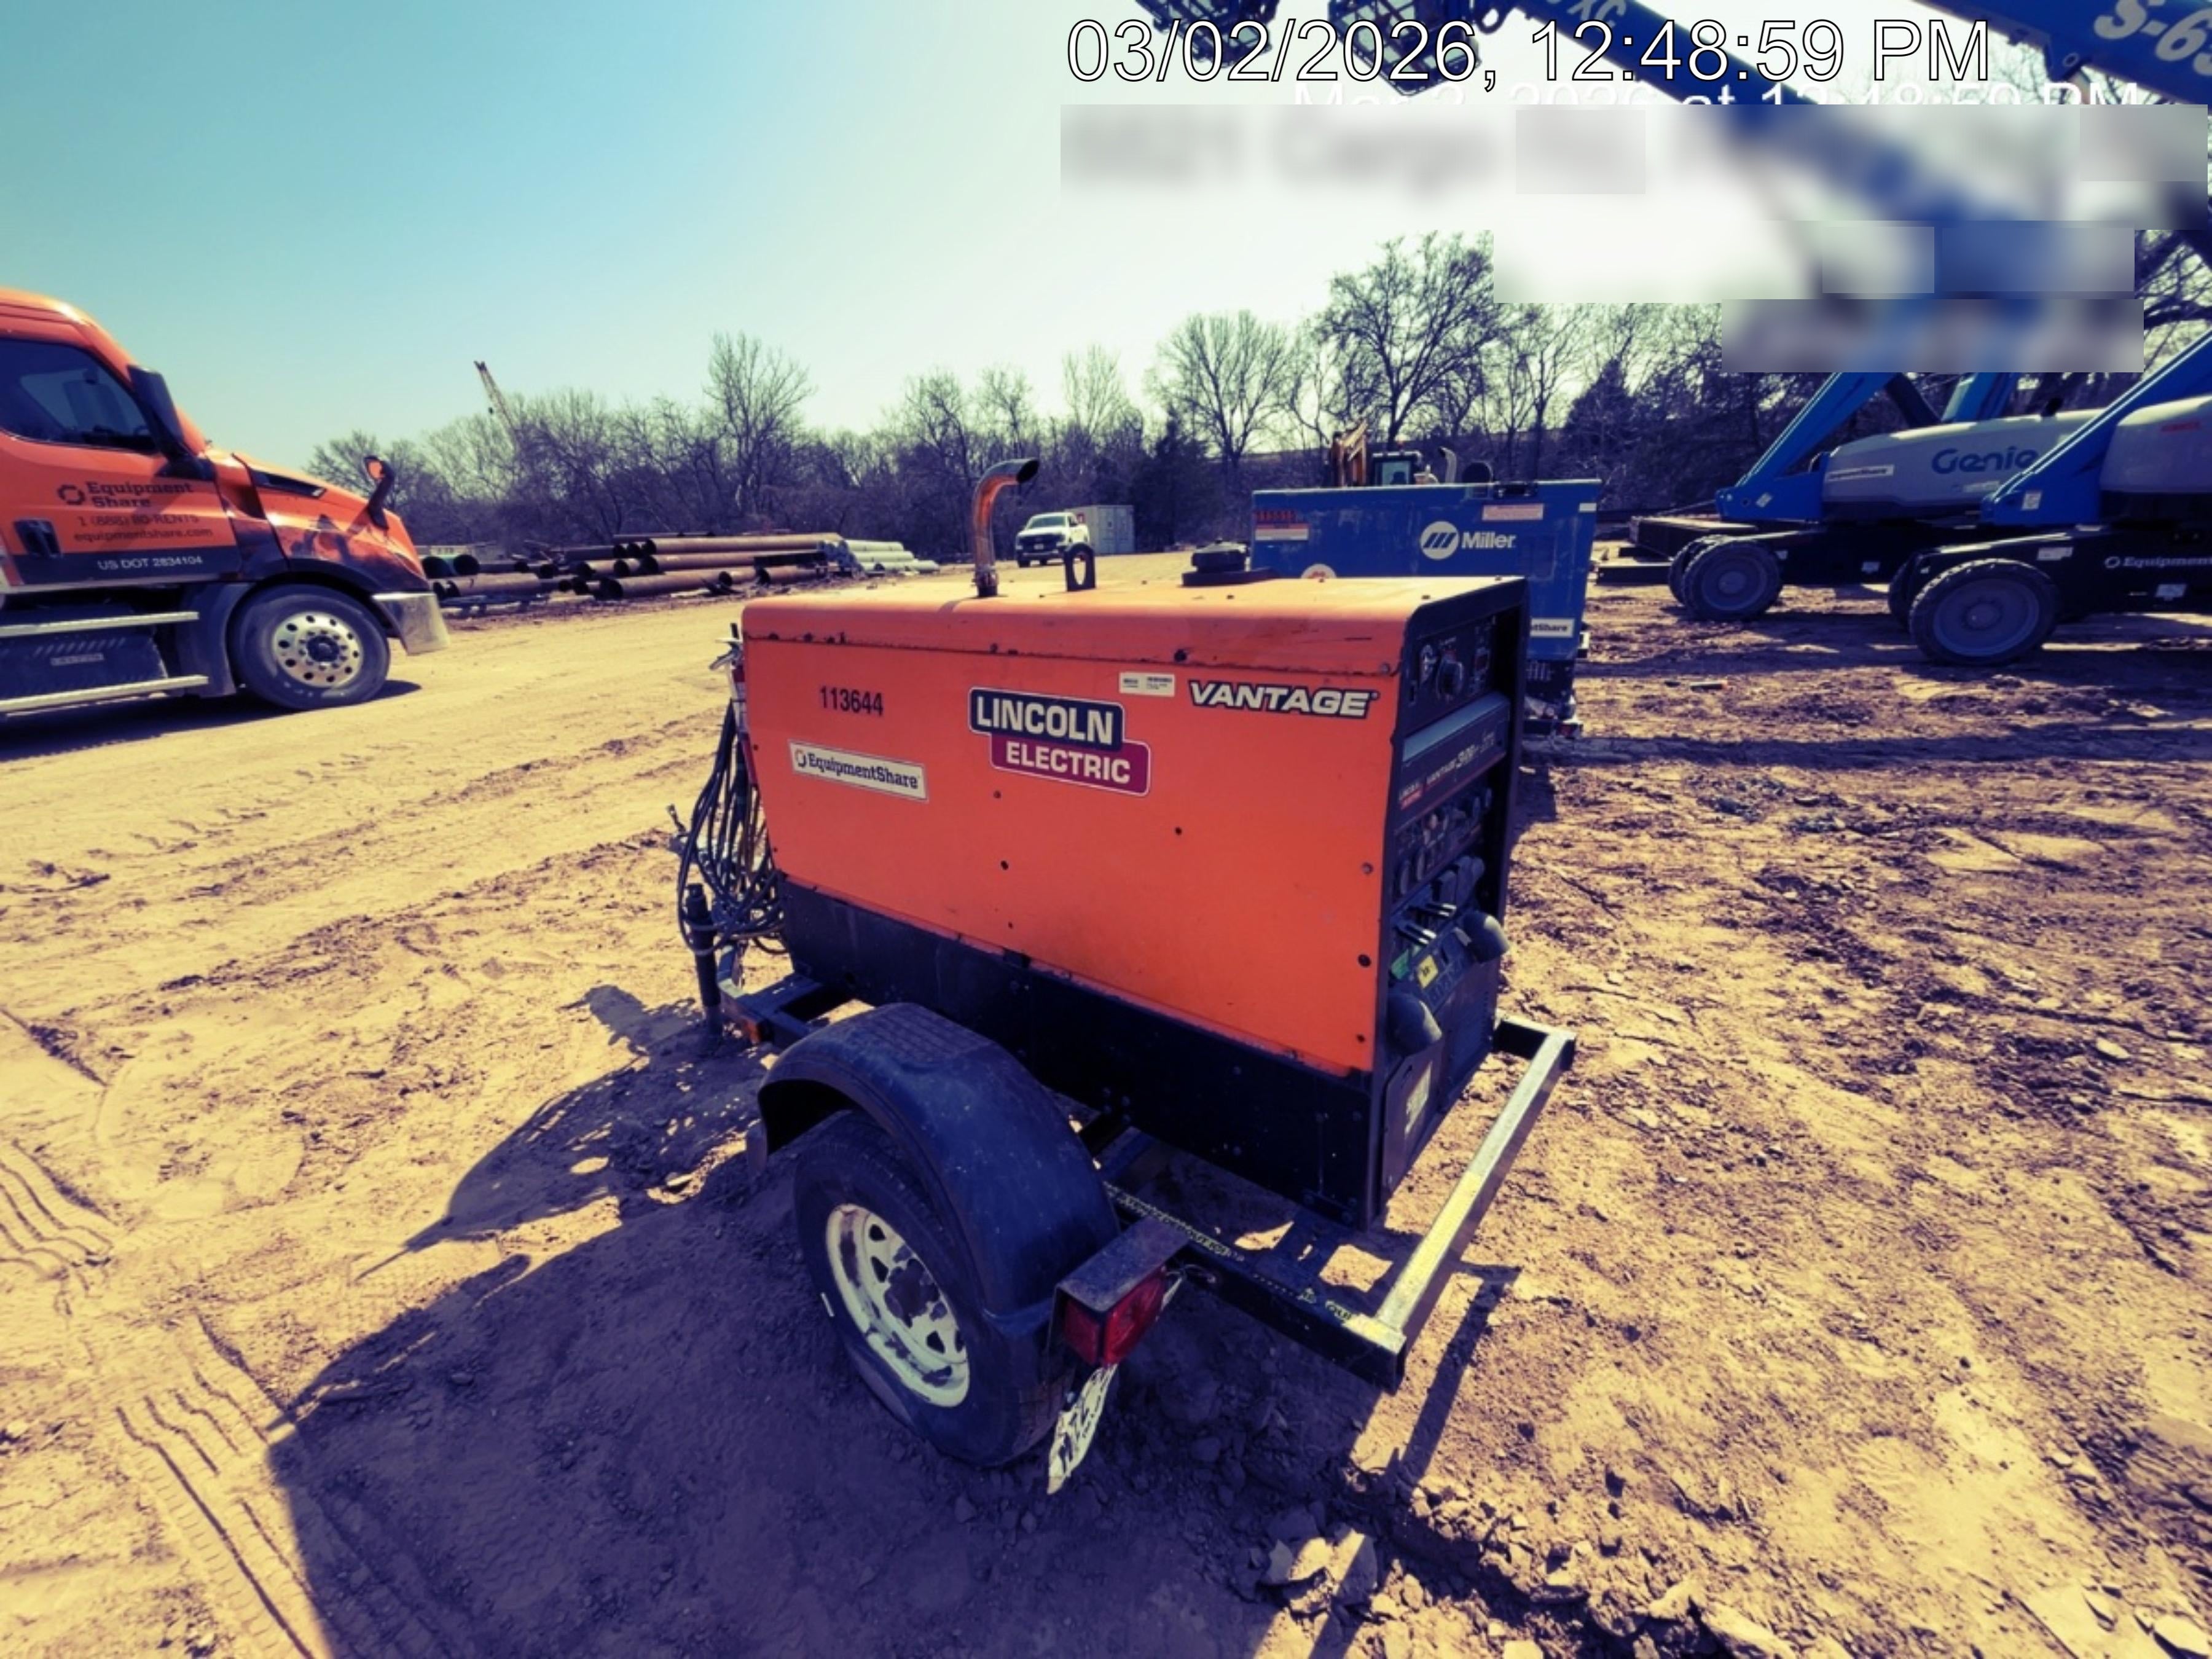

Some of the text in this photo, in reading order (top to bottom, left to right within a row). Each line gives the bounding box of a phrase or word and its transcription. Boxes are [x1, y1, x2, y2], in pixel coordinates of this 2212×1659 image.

[1931, 446, 2040, 474] Genie
[86, 481, 192, 495] Equipment
[92, 496, 151, 508] Share
[1461, 531, 1516, 549] Miller
[97, 560, 119, 570] US
[120, 559, 149, 568] DOT
[820, 685, 884, 716] 113644
[1191, 682, 1370, 716] VANTAGE
[976, 696, 1113, 746] LINCOLN
[807, 752, 919, 790] EquipmentShare
[1006, 741, 1131, 785] ELECTRIC
